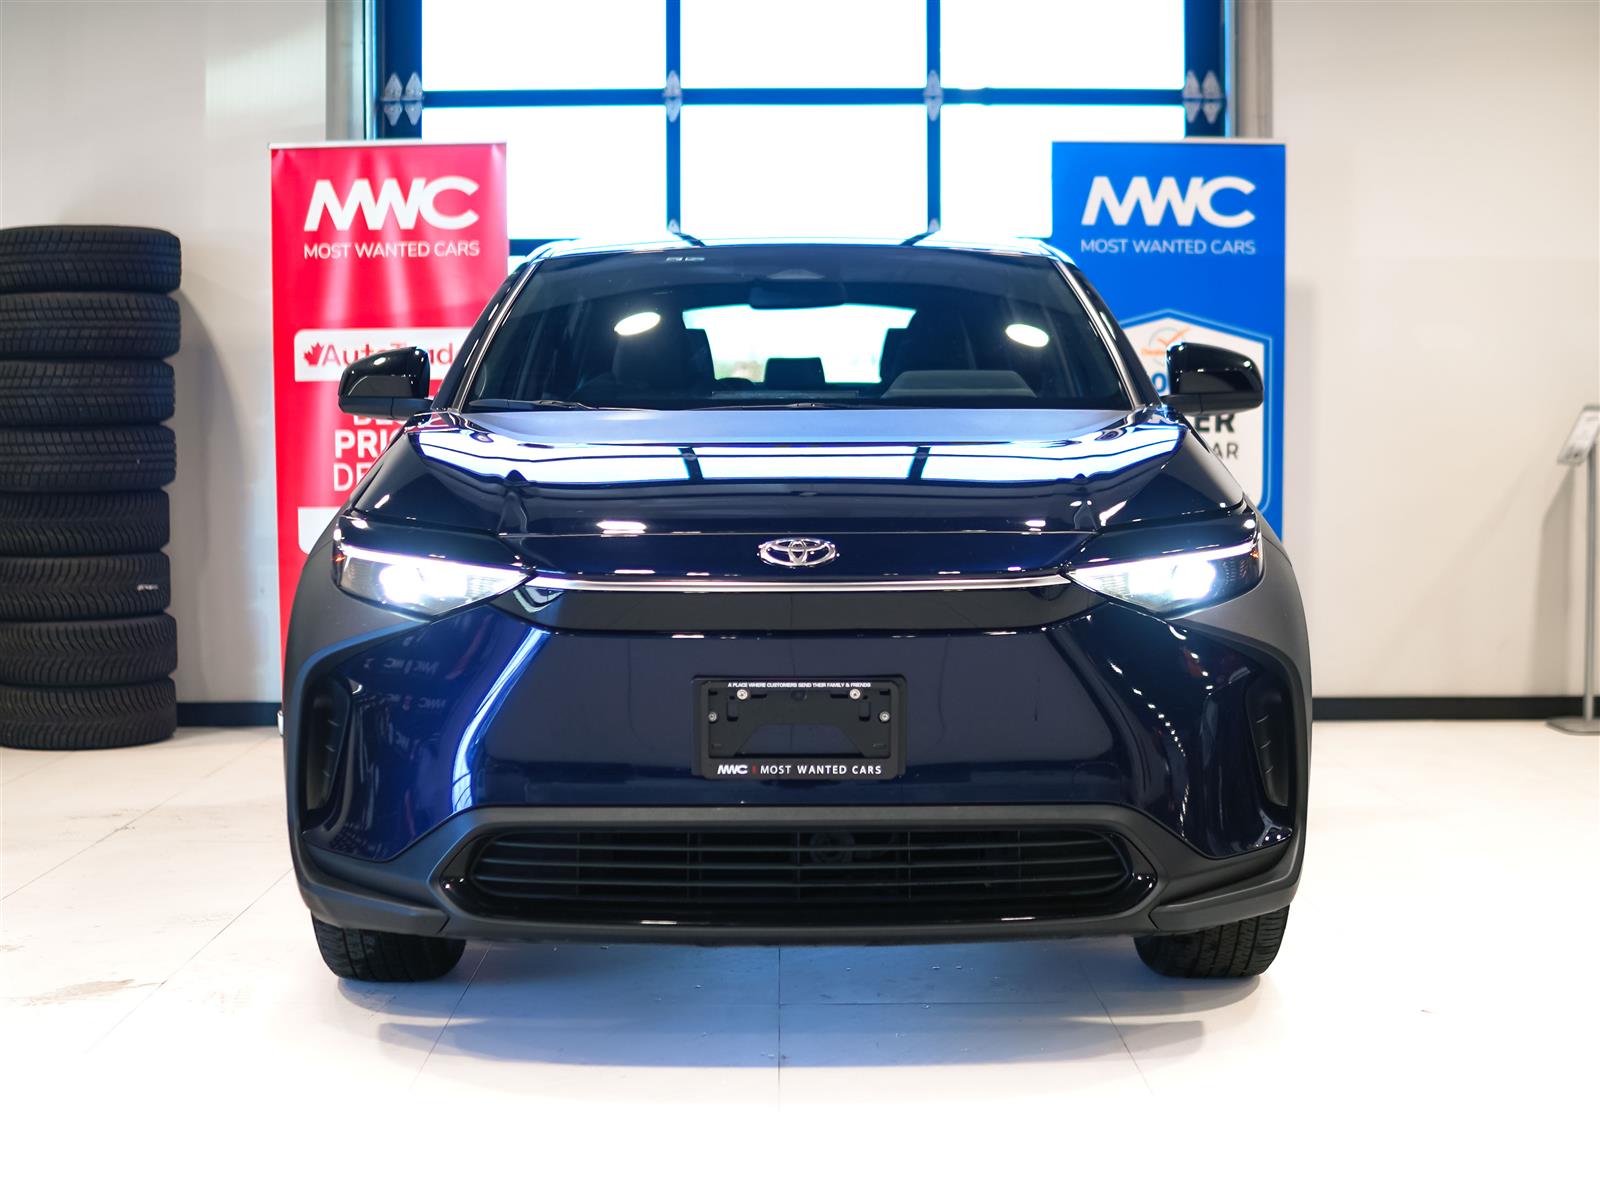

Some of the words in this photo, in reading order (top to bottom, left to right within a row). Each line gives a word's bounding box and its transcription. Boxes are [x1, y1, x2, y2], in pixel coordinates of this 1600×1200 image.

[304, 175, 480, 231] MWC
[1081, 175, 1256, 228] MWC
[303, 243, 352, 259] MOST
[355, 241, 430, 258] WANTED
[434, 240, 480, 257] CARS
[1080, 238, 1128, 253] MOST
[1132, 239, 1207, 254] WANTED
[1210, 240, 1256, 254] CARS
[717, 764, 748, 775] MWC
[760, 765, 792, 775] MOST
[797, 765, 847, 775] WANTED
[852, 765, 882, 775] CARS
